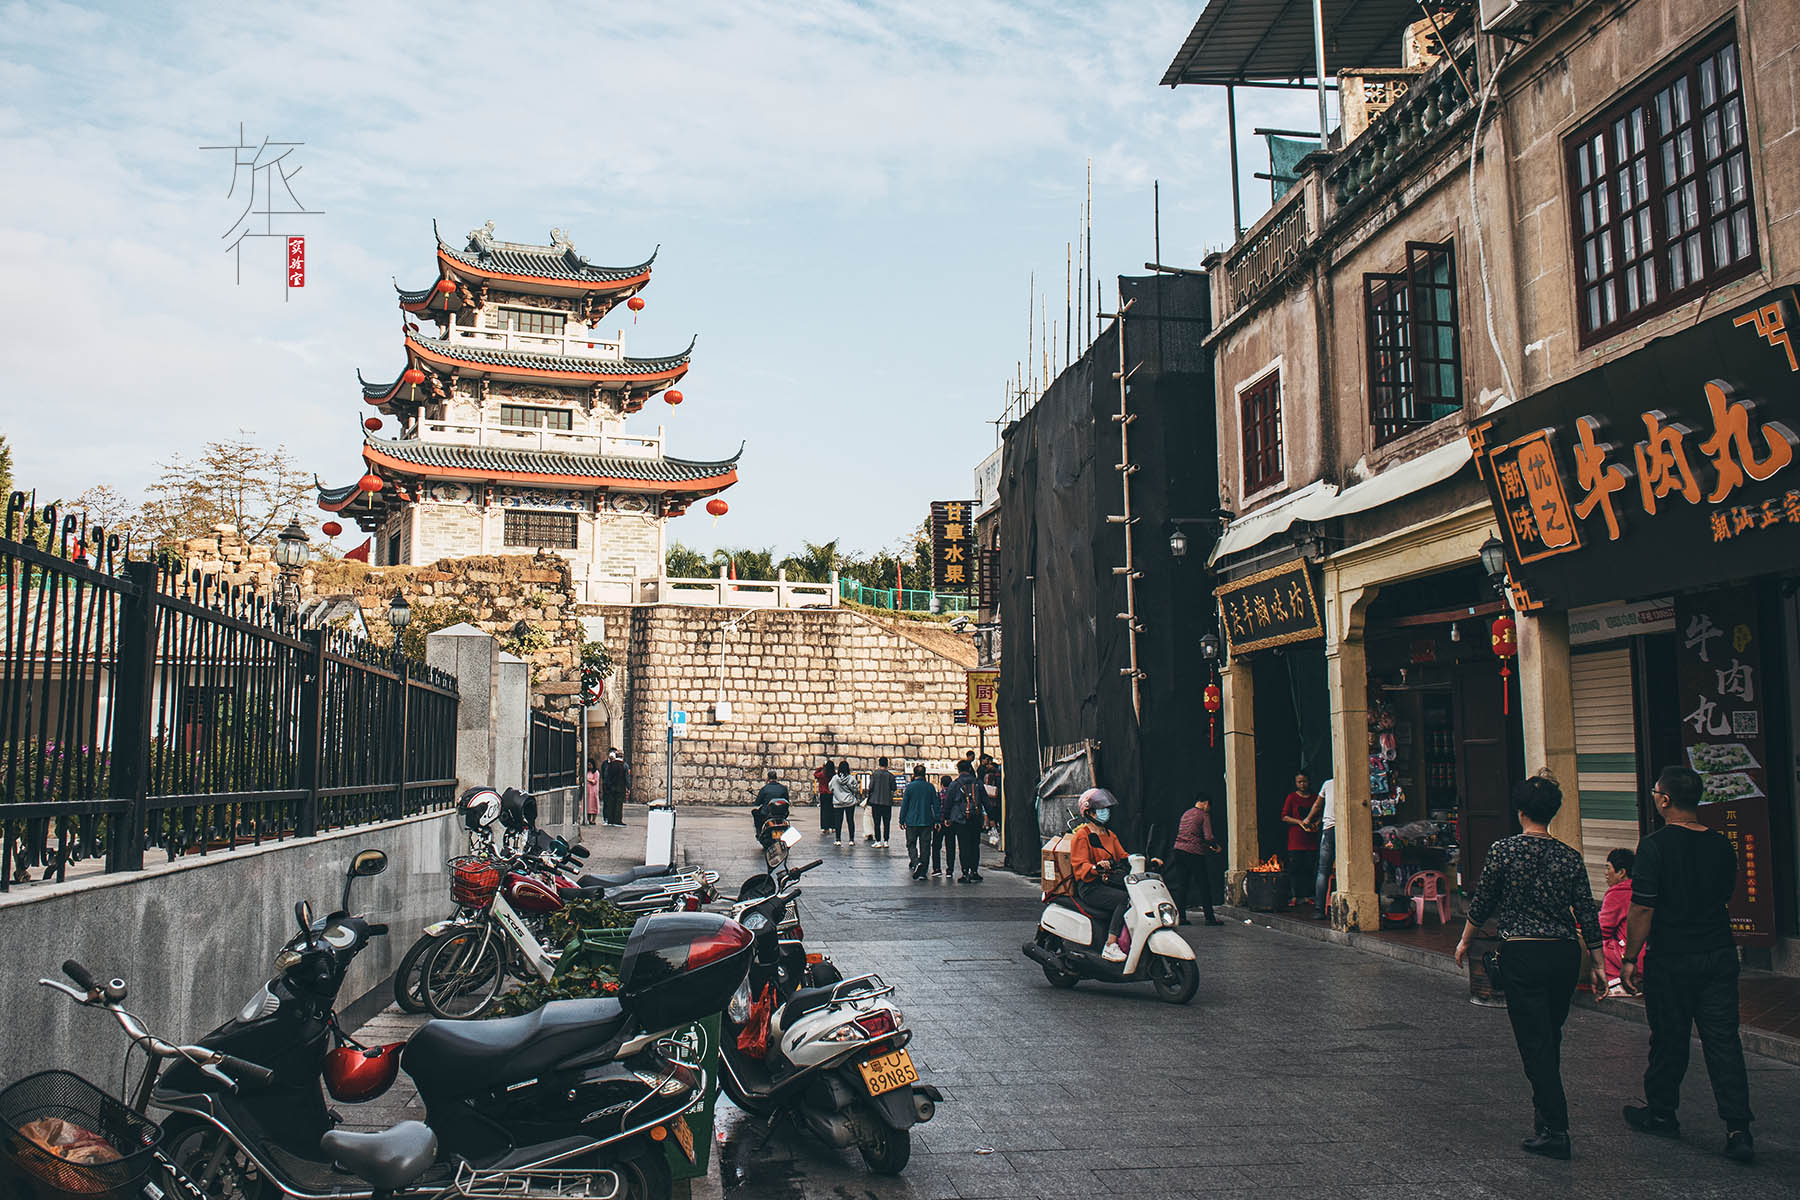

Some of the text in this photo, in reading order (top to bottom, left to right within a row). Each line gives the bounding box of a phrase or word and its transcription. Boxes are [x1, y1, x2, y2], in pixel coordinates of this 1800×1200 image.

[1528, 453, 1565, 531] 优之
[1574, 380, 1796, 540] 牛肉丸
[1499, 461, 1538, 542] 潮味
[943, 502, 966, 584] 甘草水果
[976, 684, 995, 717] 厨具
[1683, 614, 1754, 736] 牛肉丸
[870, 1065, 915, 1092] 89N85
[153, 1151, 207, 1200] FAIR
